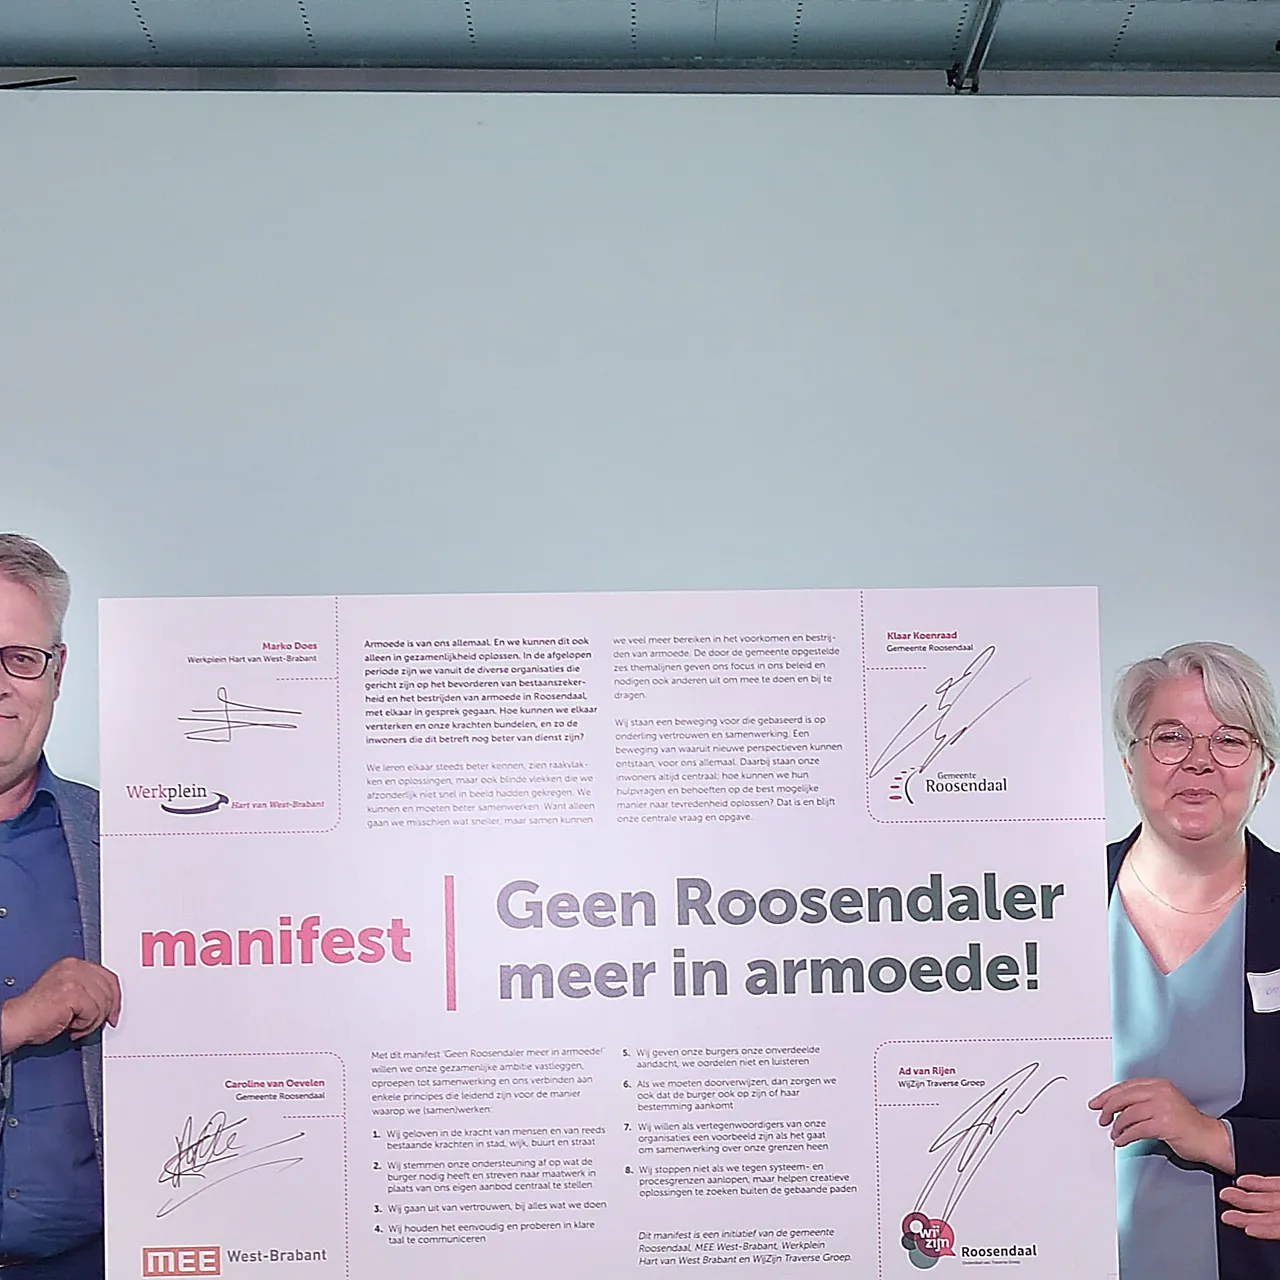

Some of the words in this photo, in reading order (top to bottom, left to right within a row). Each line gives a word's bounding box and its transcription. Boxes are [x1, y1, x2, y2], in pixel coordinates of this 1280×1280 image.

[887, 631, 912, 640] Klaar
[912, 631, 958, 640] Koenraad
[262, 641, 293, 651] Marko
[294, 641, 318, 650] Does
[363, 639, 406, 649] Armoede
[406, 639, 415, 648] is
[415, 640, 433, 648] van
[433, 640, 451, 648] ons
[493, 637, 506, 647] En
[506, 639, 521, 647] we
[521, 637, 557, 646] kunnen
[557, 637, 571, 646] dit
[571, 636, 590, 646] ook
[885, 644, 928, 653] Gemeente
[928, 643, 974, 652] Roosendaal
[186, 656, 227, 665] Werkplein
[228, 655, 246, 663] Hart
[262, 654, 318, 663] West-Brabant
[364, 653, 392, 662] alleen
[393, 653, 403, 662] in
[403, 652, 477, 664] gezamenlijkheid
[522, 651, 533, 660] In
[533, 651, 546, 660] de
[546, 650, 592, 662] afgelopen
[364, 667, 400, 678] periode
[401, 668, 418, 677] zijn
[433, 666, 462, 675] vanuit
[463, 666, 476, 675] de
[476, 666, 510, 674] diverse
[510, 664, 565, 675] organisaties
[566, 665, 581, 673] die
[364, 680, 398, 692] gericht
[398, 680, 415, 691] zijn
[416, 682, 430, 690] op
[430, 680, 446, 689] het
[447, 679, 500, 689] bevorderen
[500, 680, 517, 688] van
[364, 694, 385, 703] heid
[399, 694, 416, 703] het
[416, 693, 462, 704] bestrijden
[462, 694, 480, 702] van
[480, 693, 522, 702] armoede
[365, 709, 384, 717] met
[384, 708, 413, 717] elkaar
[414, 707, 424, 716] in
[424, 707, 461, 718] gesprek
[499, 706, 518, 715] Hoe
[519, 706, 554, 715] kunnen
[570, 705, 598, 714] elkaar
[364, 722, 413, 731] versterken
[427, 722, 451, 730] onze
[451, 721, 492, 729] krachten
[553, 720, 565, 728] zo
[566, 719, 579, 728] de
[365, 736, 408, 745] inwoners
[408, 735, 423, 744] die
[424, 735, 437, 744] dit
[438, 734, 470, 744] betreft
[471, 736, 490, 745] nog
[490, 734, 515, 743] beter
[534, 734, 563, 742] dienst
[564, 732, 585, 743] zijn?
[937, 771, 977, 780] Gemeente
[926, 778, 1007, 792] Roosendaal
[126, 784, 207, 801] Werkplein
[231, 801, 251, 809] Hart
[268, 800, 325, 809] West-Brabant
[497, 880, 657, 929] Geen
[676, 872, 1065, 926] Roosendaler
[141, 915, 412, 967] manifest
[499, 961, 657, 1000] meer
[673, 948, 728, 997] in
[745, 941, 1039, 996] armoede!
[898, 1066, 912, 1076] Ad
[912, 1068, 931, 1076] van
[931, 1066, 956, 1077] Rijen
[224, 1079, 266, 1089] Caroline
[266, 1080, 285, 1088] van
[285, 1078, 326, 1088] Oevelen
[897, 1079, 926, 1090] WijZijn
[926, 1079, 960, 1088] Traverse
[960, 1078, 986, 1088] Groep
[235, 1092, 278, 1101] Gemeente
[278, 1091, 326, 1101] Roosendaal
[638, 1165, 653, 1176] Wij
[654, 1166, 692, 1175] stoppen
[692, 1164, 710, 1173] niet
[711, 1164, 725, 1173] als
[725, 1165, 740, 1173] we
[741, 1164, 768, 1174] tegen
[811, 1163, 824, 1171] en
[639, 1177, 706, 1187] procesgrenzen
[777, 1174, 809, 1184] helpen
[809, 1174, 850, 1183] creatieve
[639, 1188, 693, 1199] oplossingen
[694, 1188, 704, 1196] te
[705, 1187, 739, 1196] zoeken
[740, 1186, 769, 1196] buiten
[770, 1186, 783, 1195] de
[783, 1184, 828, 1197] gebaande
[829, 1184, 858, 1195] paden
[638, 1231, 652, 1241] Dit
[653, 1230, 692, 1240] manifest
[693, 1231, 701, 1239] is
[702, 1231, 720, 1239] een
[721, 1228, 757, 1238] initiatief
[758, 1230, 775, 1238] van
[775, 1229, 788, 1238] de
[789, 1228, 835, 1239] gemeente
[694, 1242, 715, 1252] MEE
[781, 1240, 826, 1251] Werkplein
[961, 1244, 1037, 1257] Roosendaal
[147, 1250, 217, 1273] MEE
[227, 1249, 327, 1262] West-Brabant
[638, 1257, 659, 1266] Hart
[659, 1257, 677, 1265] van
[678, 1256, 701, 1265] West
[702, 1255, 737, 1265] Brabant
[738, 1256, 751, 1264] en
[752, 1254, 783, 1265] WijZijn
[784, 1253, 821, 1263] Traverse
